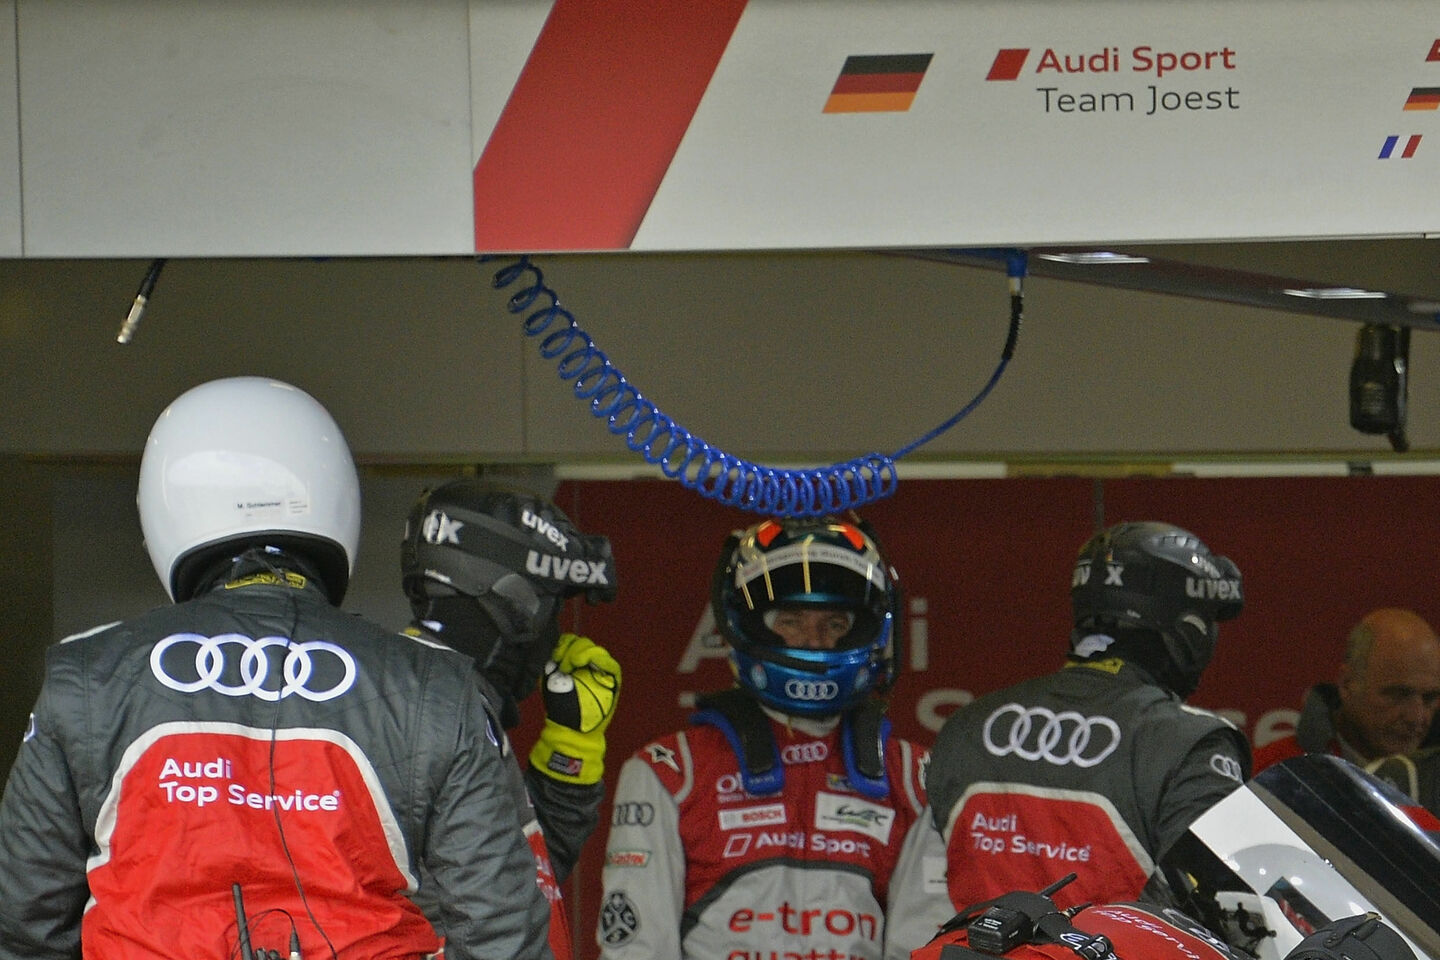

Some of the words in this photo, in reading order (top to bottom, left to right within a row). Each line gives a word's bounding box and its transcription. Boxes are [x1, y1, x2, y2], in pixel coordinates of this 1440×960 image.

[1036, 47, 1120, 73] Audi
[1131, 46, 1236, 77] Sport
[1036, 87, 1134, 113] Team
[1146, 85, 1240, 115] Joest
[522, 509, 569, 552] uvex
[526, 549, 608, 585] uvex
[1185, 576, 1241, 600] uvex
[158, 757, 231, 779] Audi
[160, 781, 218, 805] Top
[228, 788, 338, 811] Service
[971, 813, 1016, 832] Audi
[756, 831, 805, 849] Audi
[810, 833, 870, 857] Sport
[971, 832, 1005, 854] Top
[1011, 835, 1090, 862] Service
[729, 902, 877, 941] e-tron
